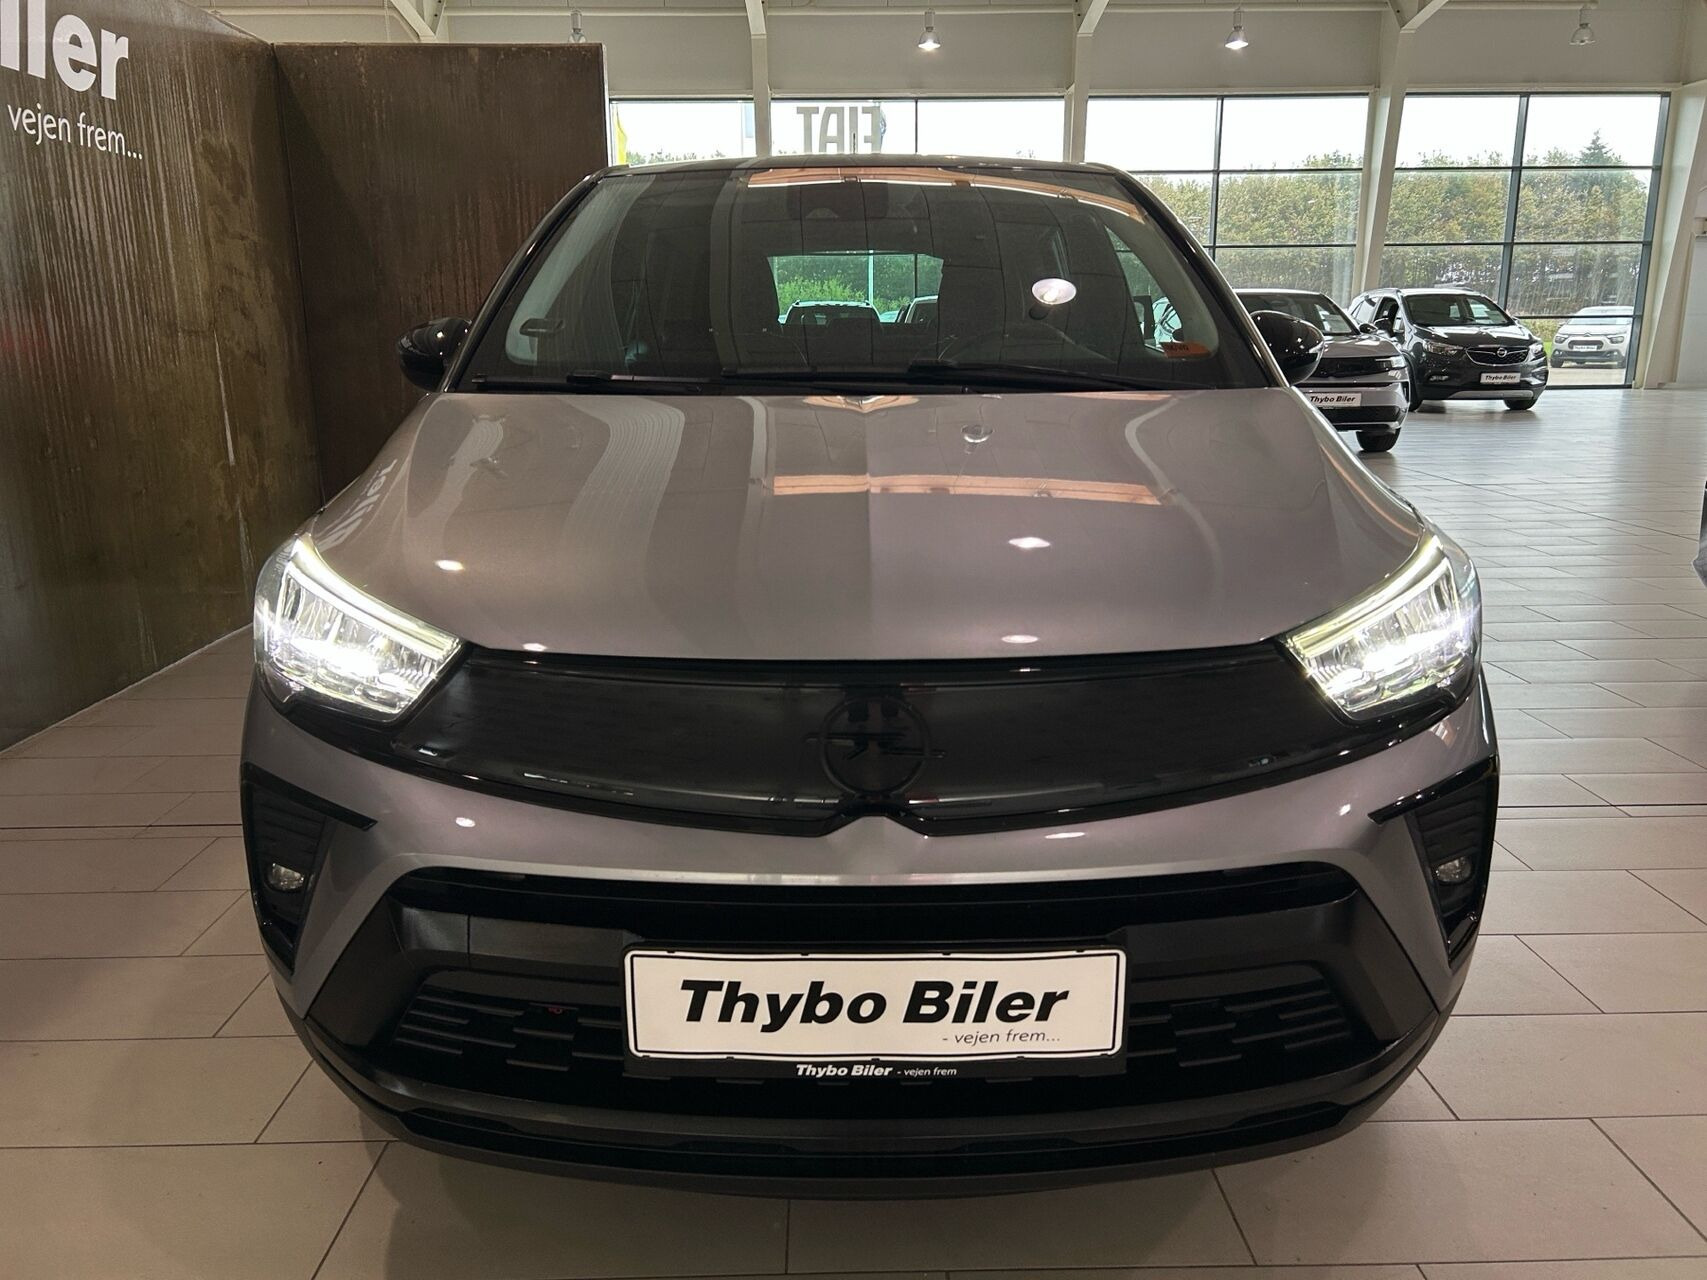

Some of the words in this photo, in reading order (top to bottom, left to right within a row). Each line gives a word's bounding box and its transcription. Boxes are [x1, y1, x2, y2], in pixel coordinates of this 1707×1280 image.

[7, 102, 71, 145] vejen
[77, 111, 143, 160] frem...
[1310, 396, 1335, 404] Thybo
[680, 979, 887, 1033] Thybo
[902, 980, 1070, 1024] Biler
[954, 1031, 1000, 1046] vejen
[1006, 1028, 1061, 1042] frem...
[796, 1064, 849, 1078] Thybo
[850, 1064, 894, 1077] Biler
[904, 1067, 931, 1078] vejen
[933, 1066, 958, 1076] frem
